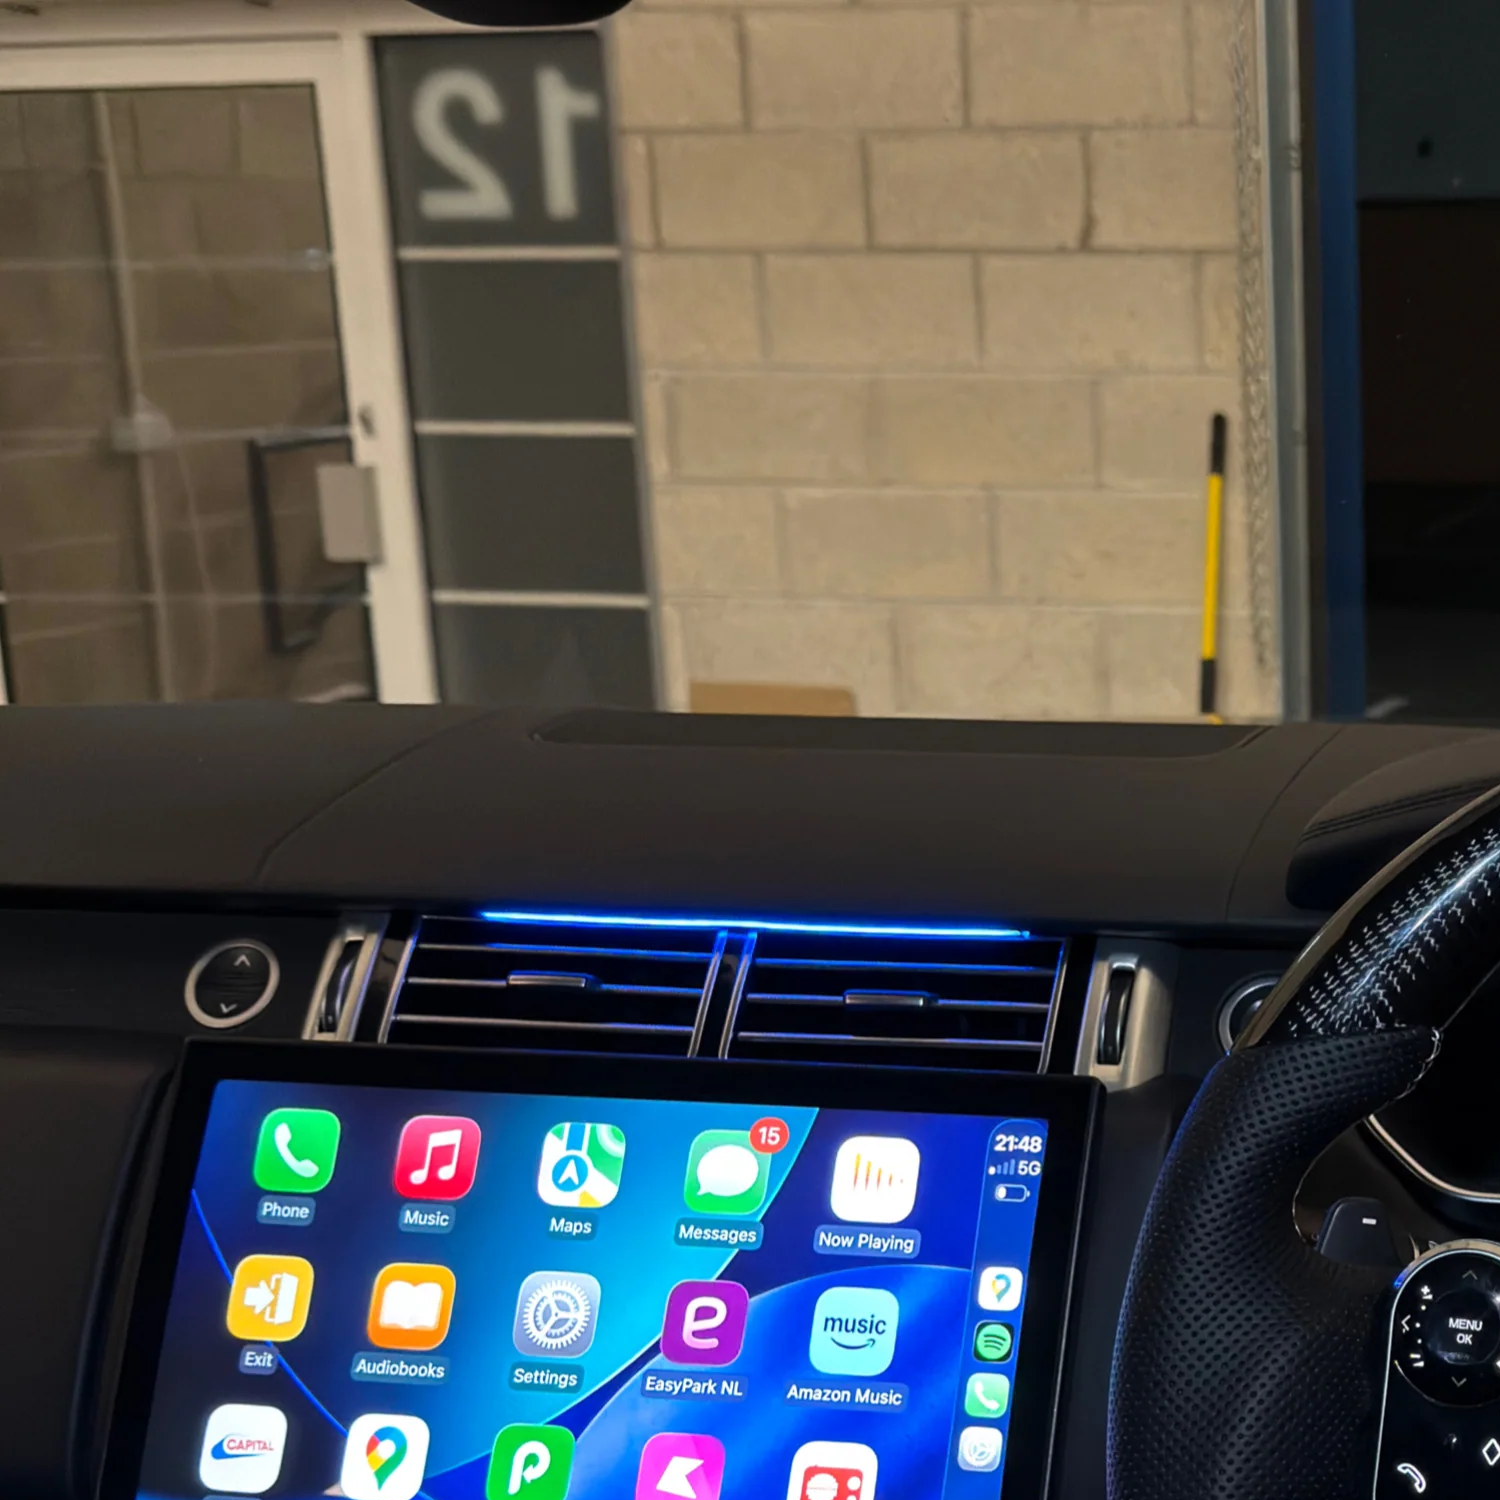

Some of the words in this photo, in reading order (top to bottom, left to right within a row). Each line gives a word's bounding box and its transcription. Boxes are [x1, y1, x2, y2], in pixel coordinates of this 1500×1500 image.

[758, 1126, 781, 1146] 15
[994, 1135, 1043, 1153] 21:48
[1017, 1160, 1041, 1176] 5G
[262, 1202, 310, 1220] Phone
[404, 1210, 449, 1227] Music
[549, 1217, 592, 1236] Maps
[679, 1224, 756, 1243] Messages
[818, 1232, 853, 1249] Now
[858, 1234, 914, 1254] Playing
[823, 1314, 887, 1335] music
[1448, 1317, 1483, 1331] MENU
[1456, 1332, 1473, 1346] OK
[244, 1351, 273, 1369] Exit
[355, 1358, 446, 1379] Audiobooks
[513, 1368, 578, 1389] Settings
[645, 1377, 717, 1397] EasyPark
[721, 1380, 743, 1396] NL
[787, 1384, 850, 1402] Amazon
[854, 1388, 902, 1405] Music
[227, 1439, 274, 1453] CAPITAL
